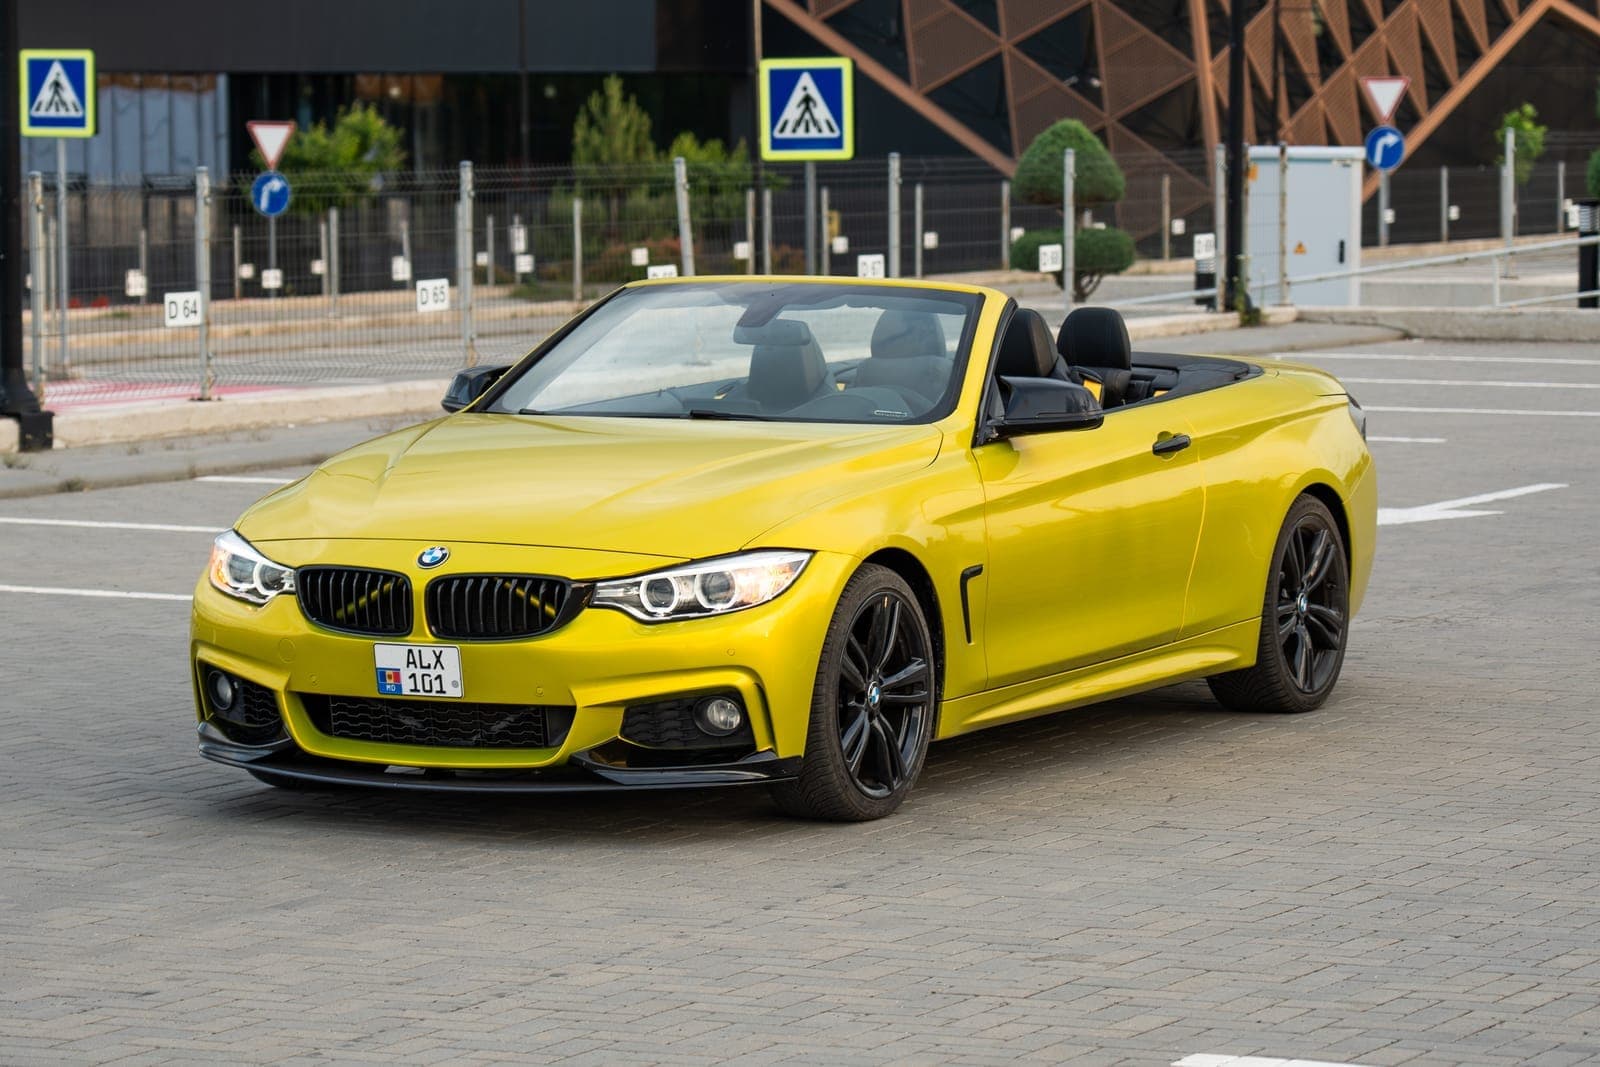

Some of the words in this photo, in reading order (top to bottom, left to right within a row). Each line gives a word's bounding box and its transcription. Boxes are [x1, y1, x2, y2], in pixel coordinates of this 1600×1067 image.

[420, 288, 428, 305] D
[432, 286, 446, 304] 65
[168, 301, 178, 319] D
[183, 300, 198, 318] 64
[406, 648, 445, 670] ALX
[408, 673, 446, 694] 101
